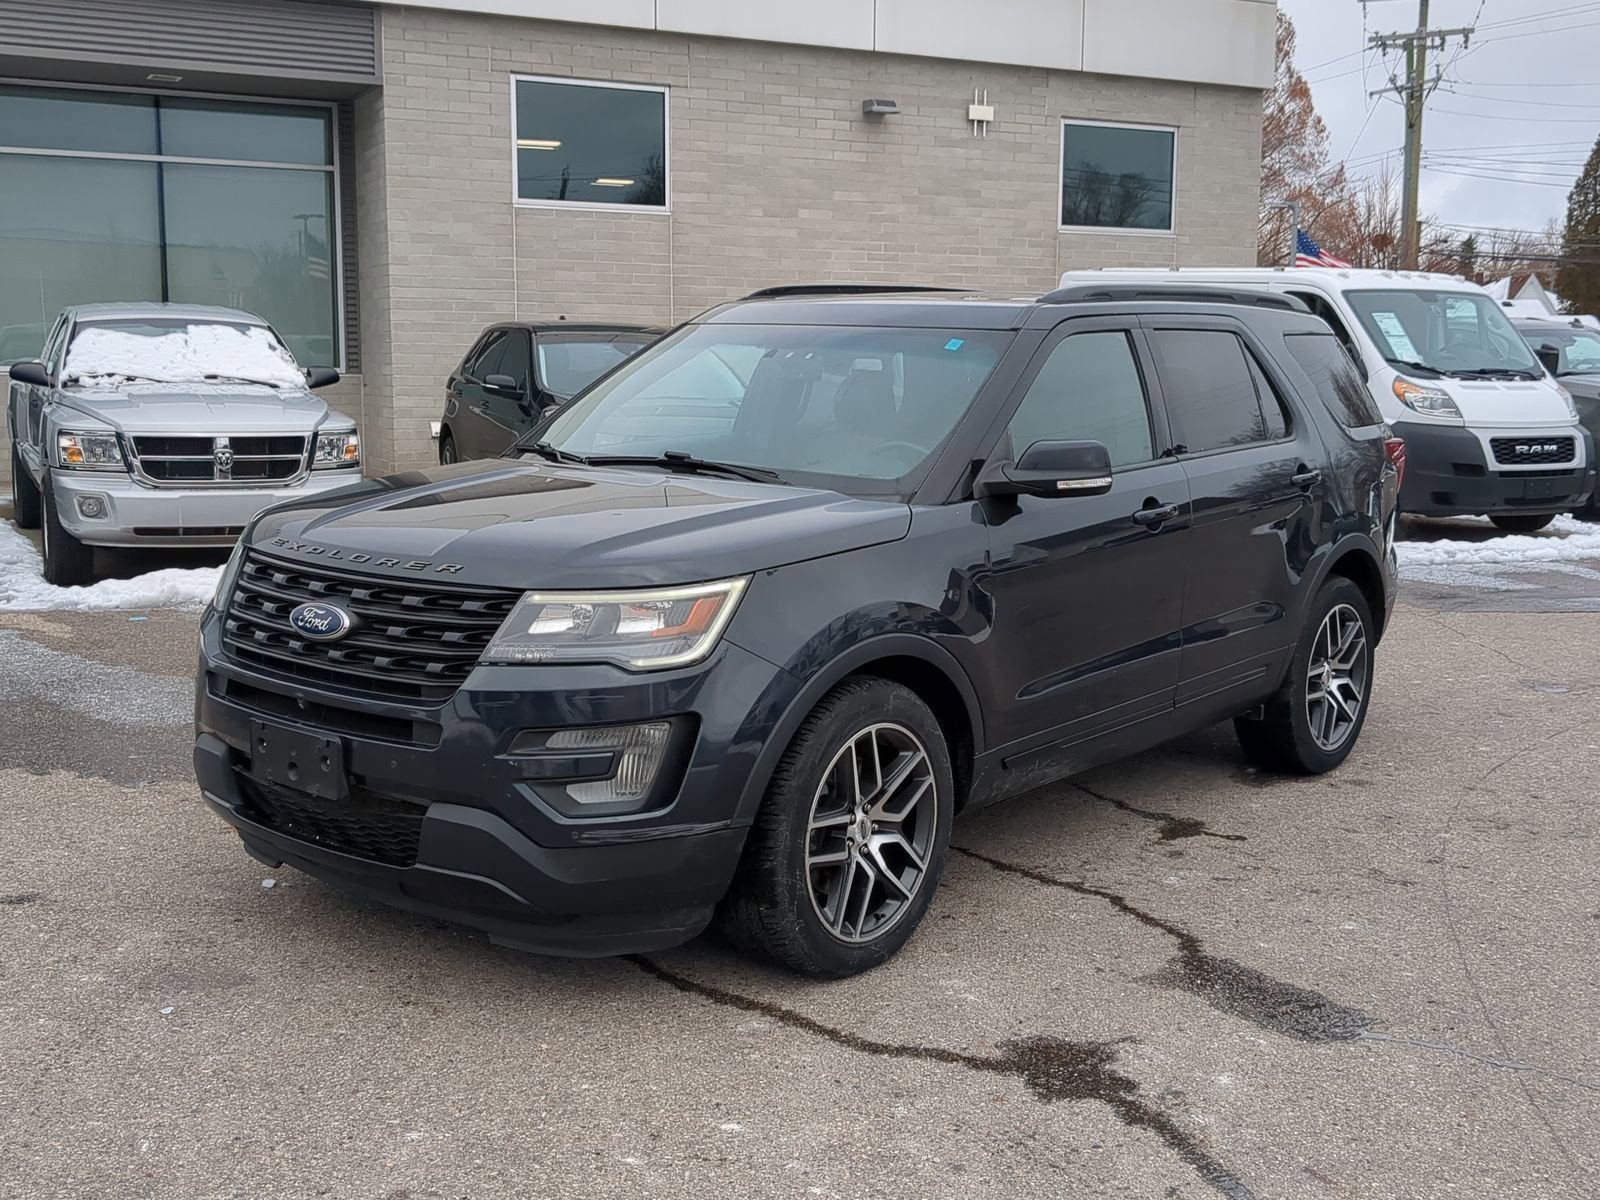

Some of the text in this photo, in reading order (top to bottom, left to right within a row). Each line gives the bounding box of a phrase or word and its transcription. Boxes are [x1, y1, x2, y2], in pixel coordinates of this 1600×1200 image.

[1515, 445, 1557, 454] RAM
[271, 537, 465, 574] EXPLORER
[298, 607, 332, 631] Ford
